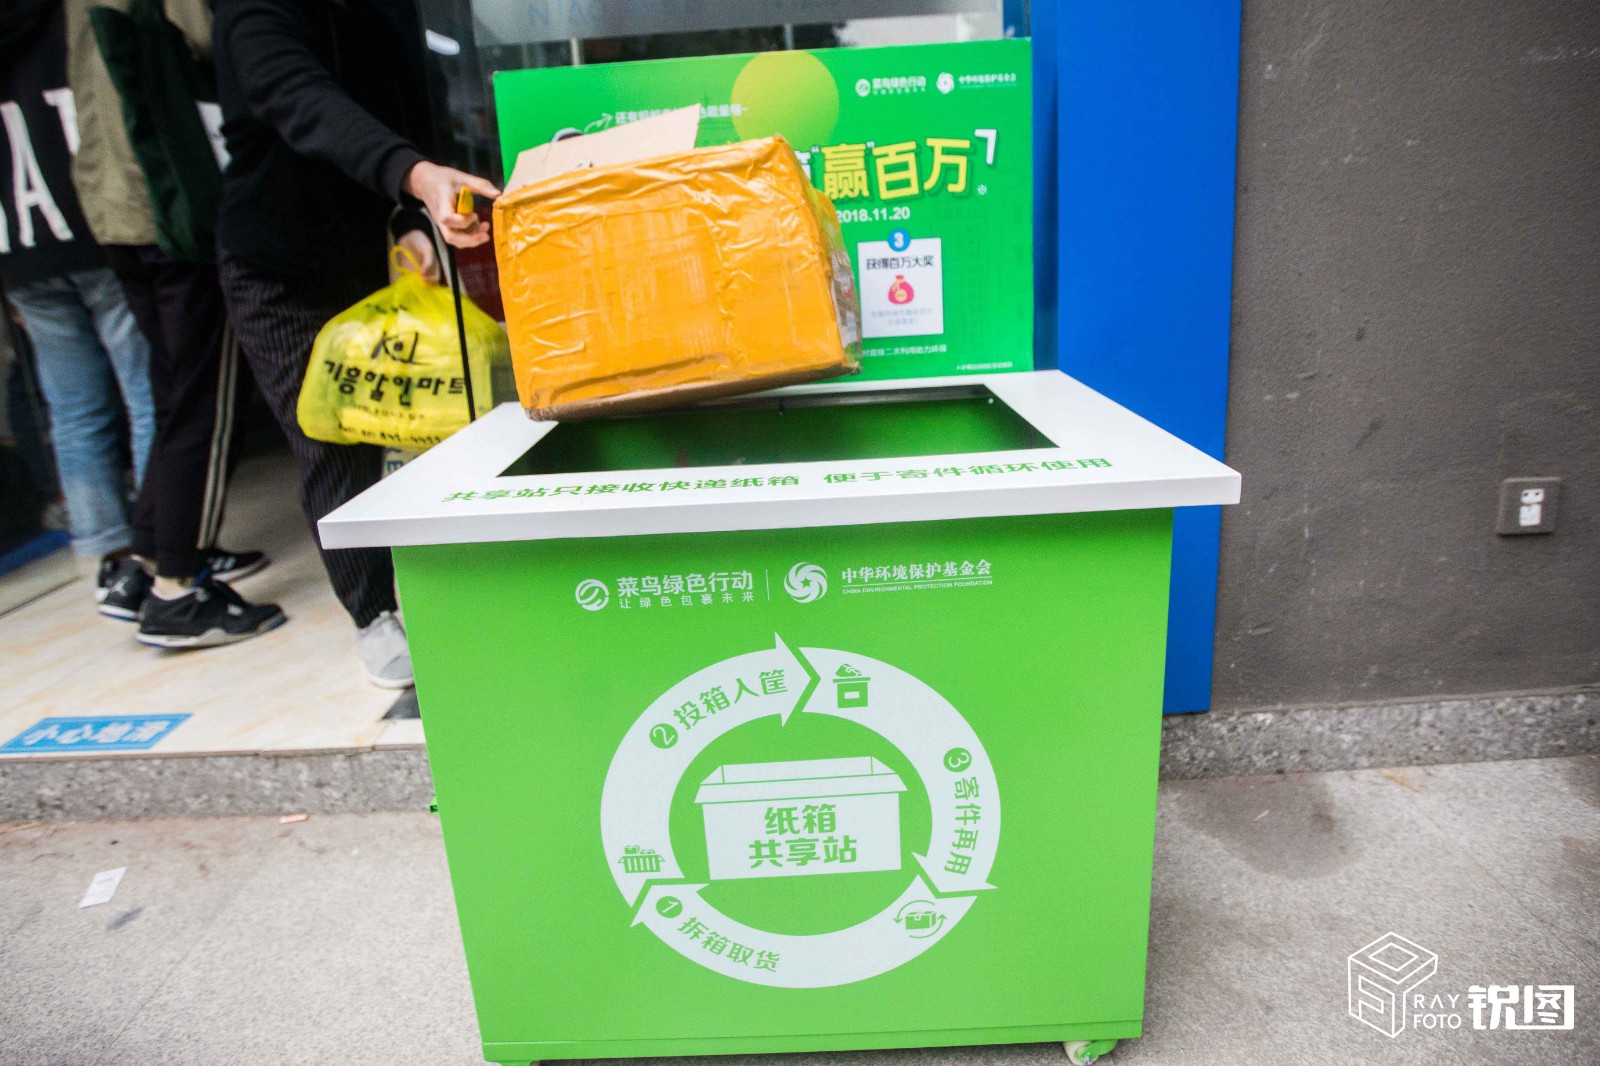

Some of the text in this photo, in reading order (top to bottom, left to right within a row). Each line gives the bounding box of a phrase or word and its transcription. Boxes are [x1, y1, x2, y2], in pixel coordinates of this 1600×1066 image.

[866, 255, 934, 270] 获得百万大奖
[324, 359, 466, 407] 기흥할인마트
[441, 457, 1113, 503] 共享站只接收快递纸箱 便于寄件循环使用
[616, 570, 754, 598] 菜鸟绿色行动
[841, 559, 992, 584] 中华环境保护基金会
[842, 579, 993, 595] CHINA ENVIRONMENTAL PROTECTION FOUNDATION
[618, 591, 755, 609] 让绿色包裹未来
[764, 803, 837, 835] 纸箱
[944, 776, 982, 875] 寄件再用
[748, 834, 857, 869] 共享站
[677, 917, 781, 972] 拆箱取货
